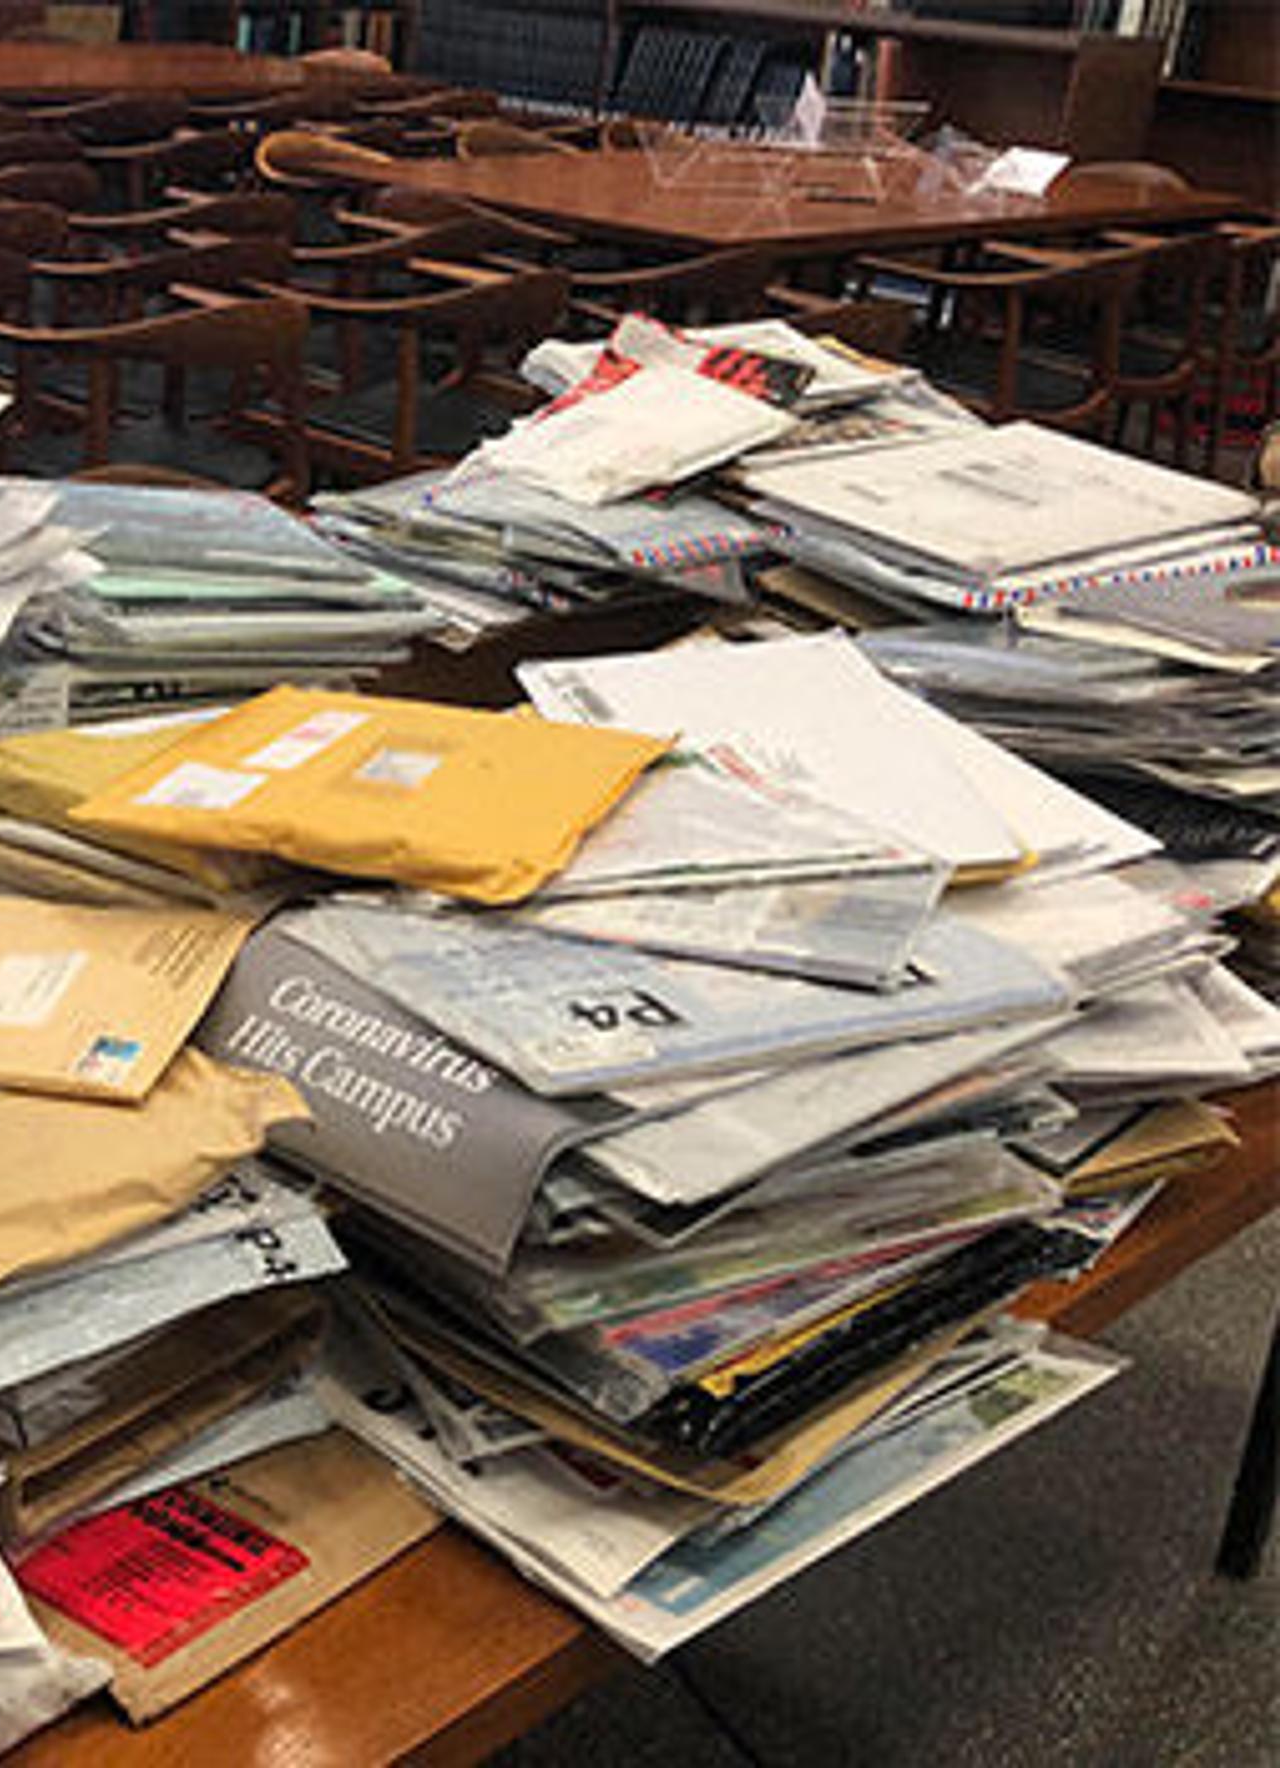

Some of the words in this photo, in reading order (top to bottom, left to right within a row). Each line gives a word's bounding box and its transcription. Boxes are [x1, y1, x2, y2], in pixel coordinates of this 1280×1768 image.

[228, 1013, 306, 1074] Hits
[299, 1046, 466, 1150] Campus
[269, 974, 500, 1093] Coronavirus
